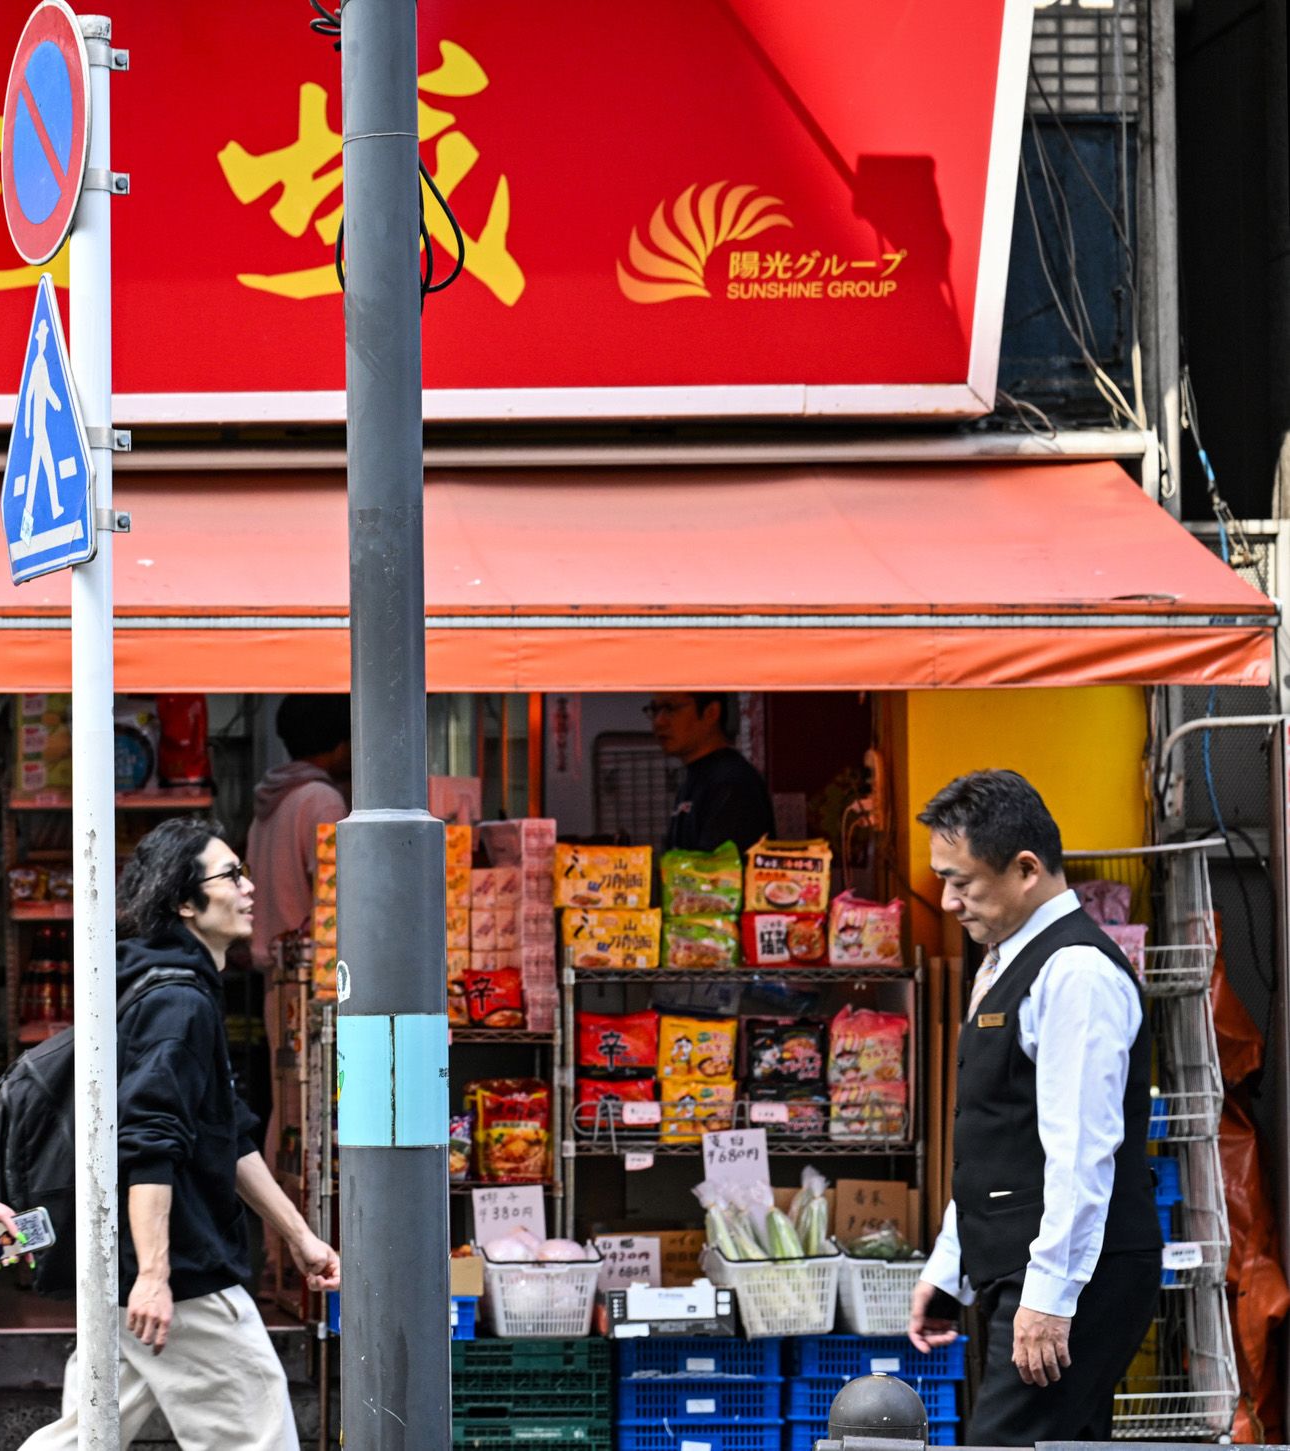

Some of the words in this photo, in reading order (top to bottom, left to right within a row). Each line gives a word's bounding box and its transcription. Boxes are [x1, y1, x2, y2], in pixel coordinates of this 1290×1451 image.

[729, 250, 907, 279] 陽光グループ
[727, 281, 823, 299] SUNSHINE
[827, 280, 897, 298] GROUP
[468, 976, 495, 1012] 辛
[598, 1031, 629, 1072] 辛
